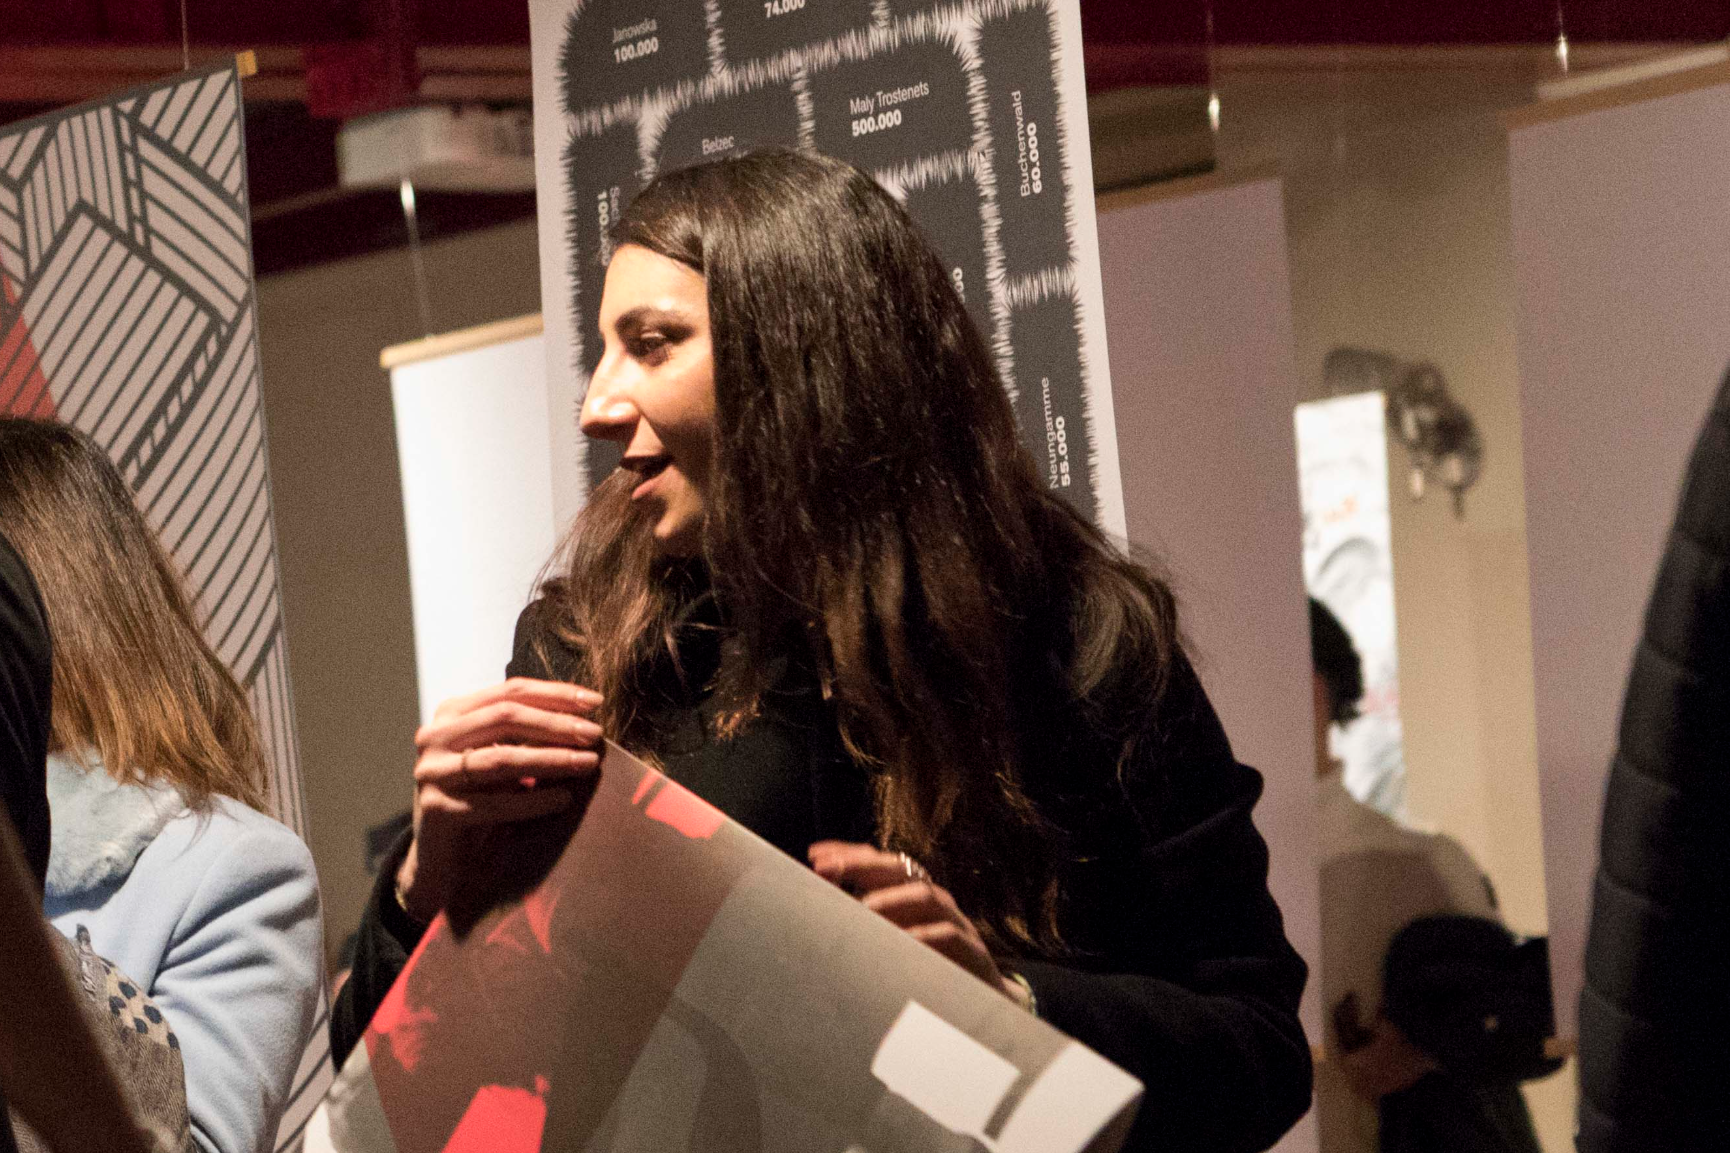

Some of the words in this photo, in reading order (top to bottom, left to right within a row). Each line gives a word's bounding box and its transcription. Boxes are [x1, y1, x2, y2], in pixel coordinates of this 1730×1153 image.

[614, 37, 659, 63] 100.000
[849, 95, 875, 115] Maly
[876, 81, 930, 108] Trostenets
[852, 109, 902, 137] 500.000
[1011, 90, 1031, 197] Buchenwald
[1026, 122, 1043, 194] 60.000
[1041, 377, 1059, 490] Neungamme
[1055, 415, 1071, 488] 55.000
